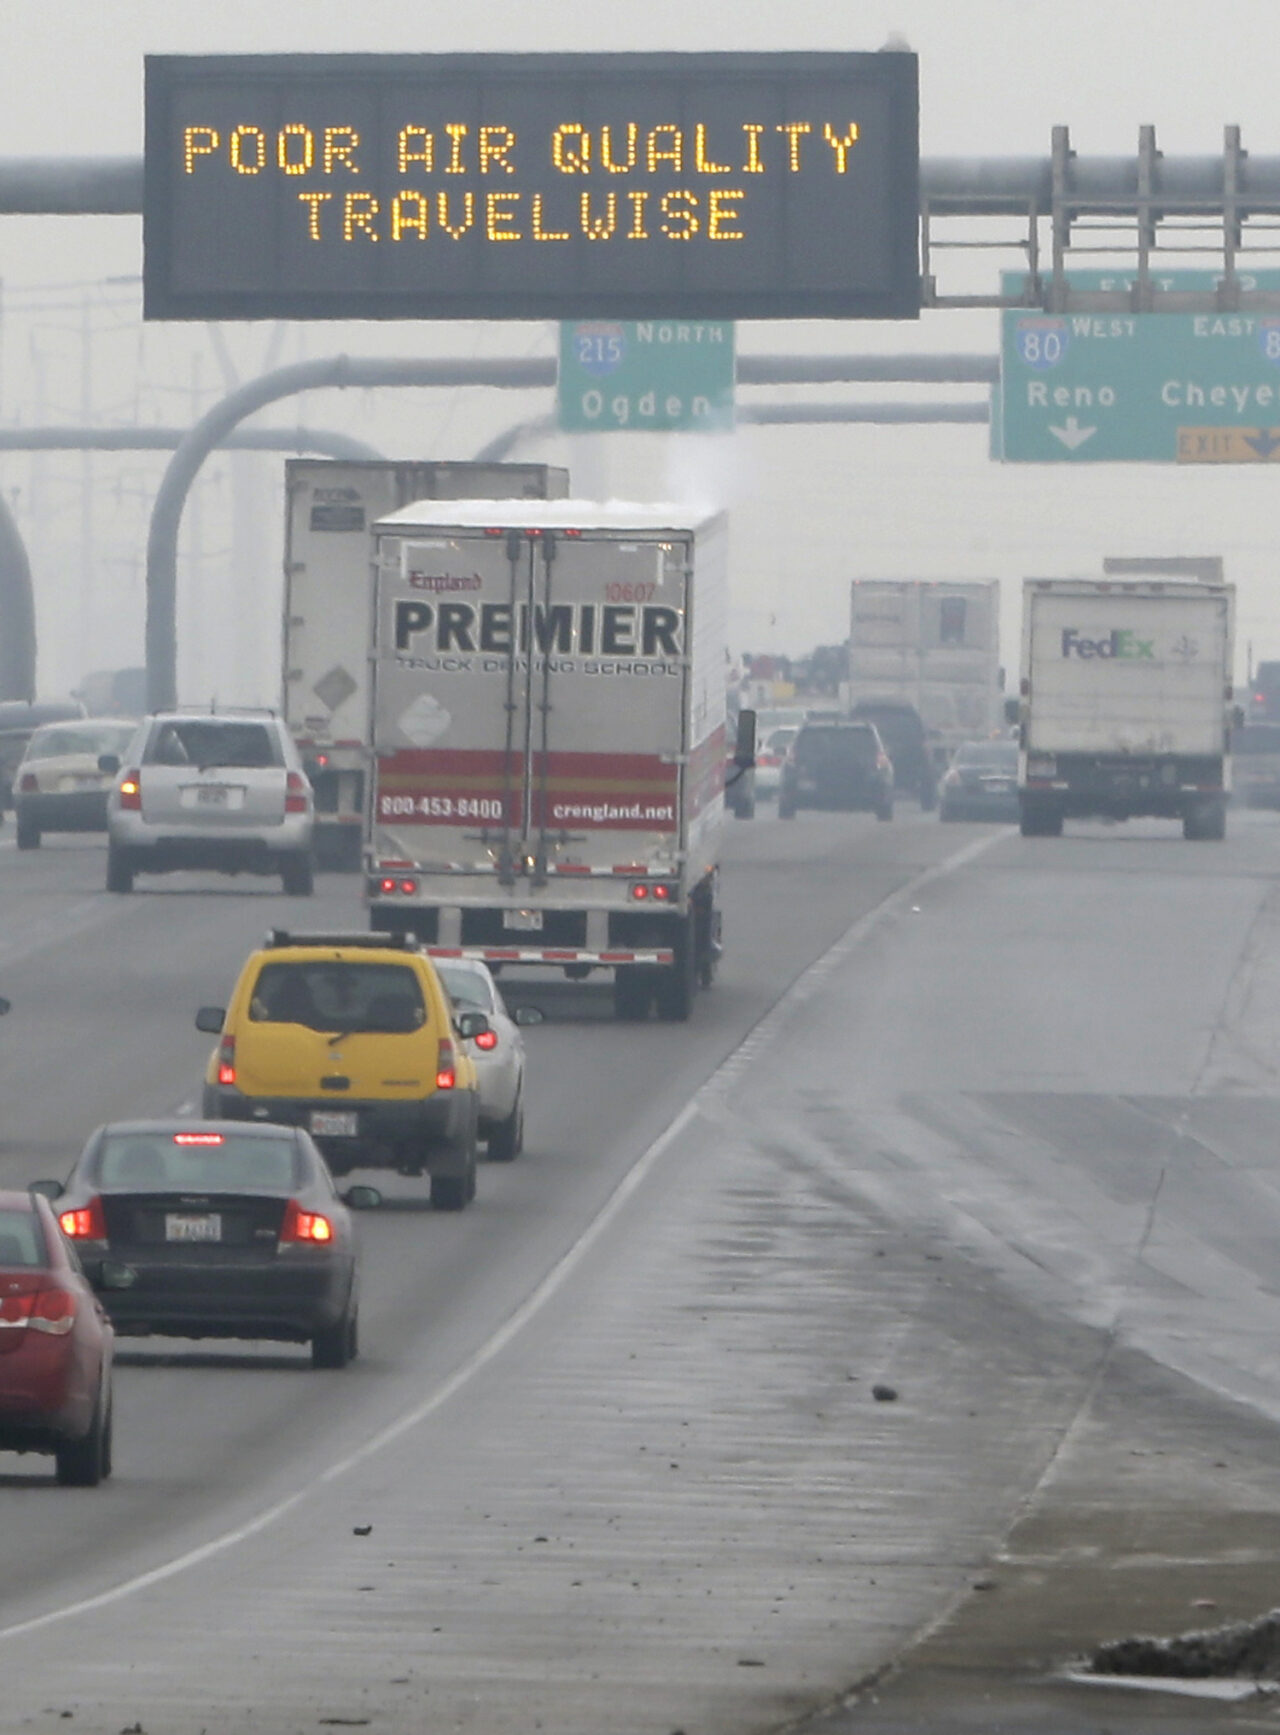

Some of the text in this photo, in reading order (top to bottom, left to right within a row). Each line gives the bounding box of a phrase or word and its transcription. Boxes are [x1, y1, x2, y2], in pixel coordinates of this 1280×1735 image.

[184, 122, 859, 175] POOR AIR QUALITY
[299, 190, 745, 242] TRAVELWISE
[637, 322, 723, 343] NORTH
[1073, 318, 1136, 337] WEST
[1193, 318, 1255, 336] EAST
[579, 338, 620, 362] 215
[1024, 332, 1061, 361] 80
[1027, 382, 1116, 407] Reno
[582, 390, 710, 424] Ogden
[1180, 435, 1232, 455] EXIT
[606, 582, 656, 603] 10607
[395, 600, 681, 656] PREMIER
[1061, 628, 1155, 660] FedEx
[396, 656, 472, 672] TRUCK
[584, 662, 679, 677] SCHOOL
[554, 803, 675, 821] crengland.net
